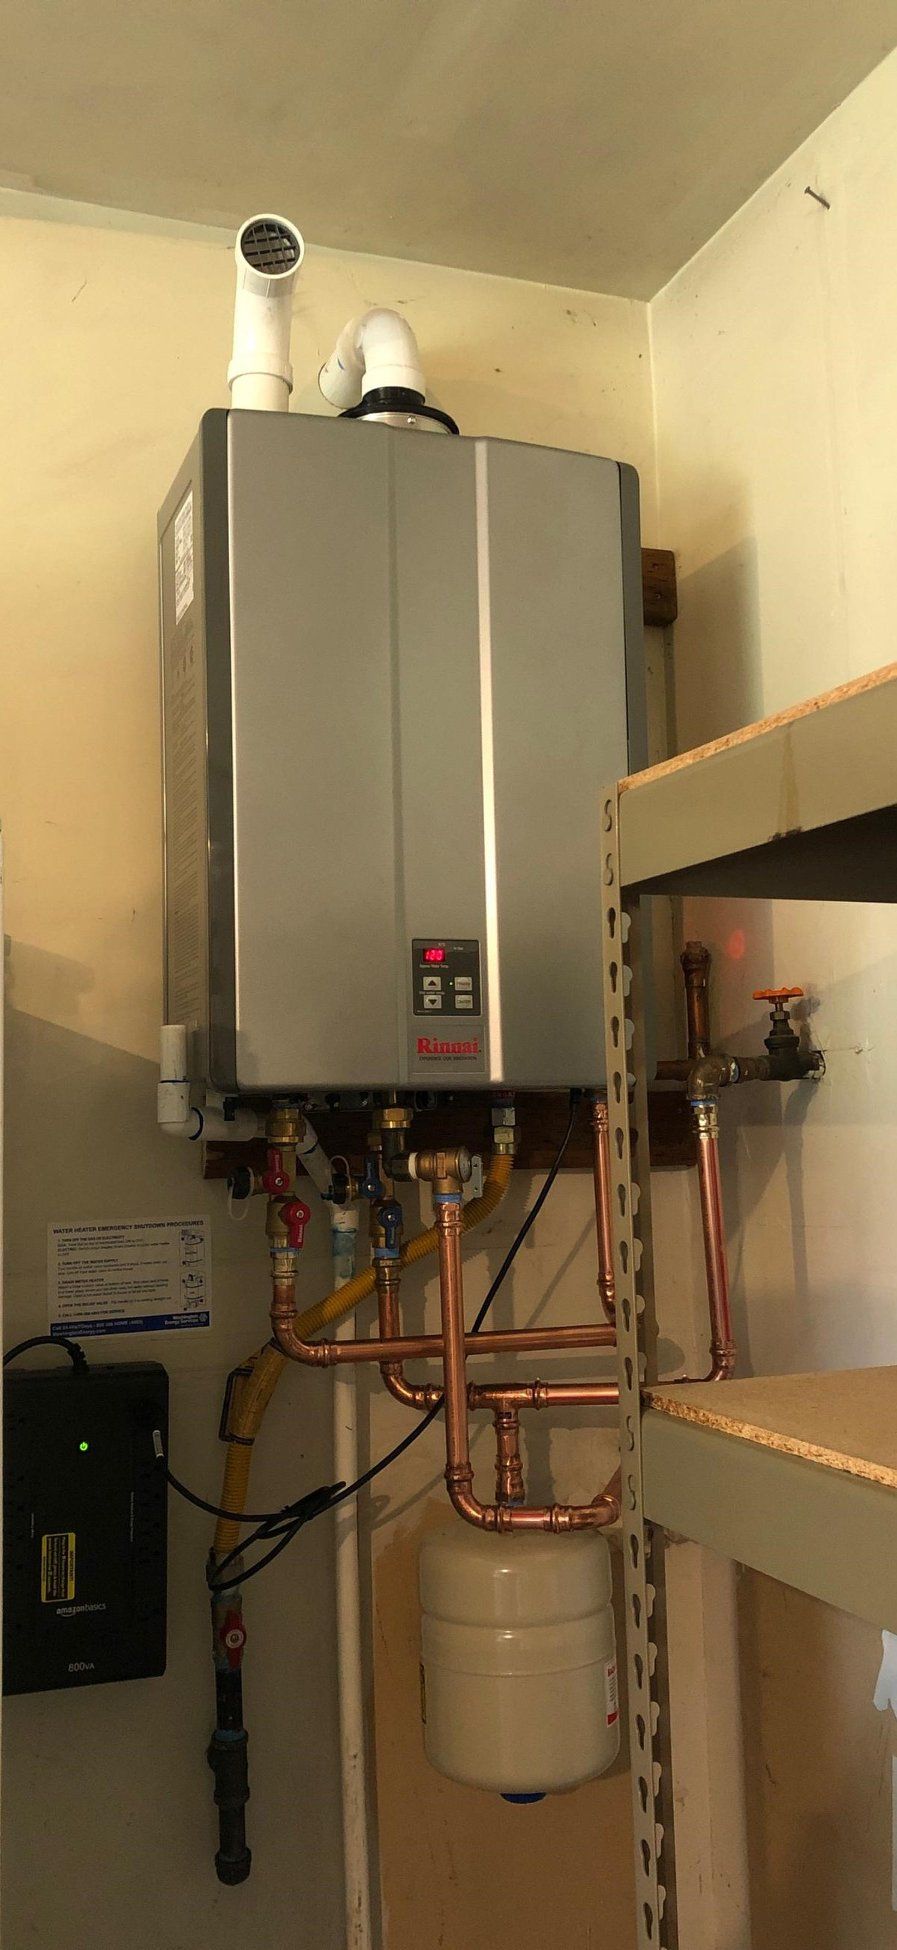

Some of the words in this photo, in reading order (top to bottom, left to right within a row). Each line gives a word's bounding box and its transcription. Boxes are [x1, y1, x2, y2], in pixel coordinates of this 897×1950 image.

[417, 1037, 479, 1053] Rinnai
[98, 1224, 132, 1232] EMERGENCY
[134, 1222, 165, 1230] SHUTDOWN
[56, 1602, 106, 1615] amazonbasics
[68, 1661, 95, 1672] 800VA
